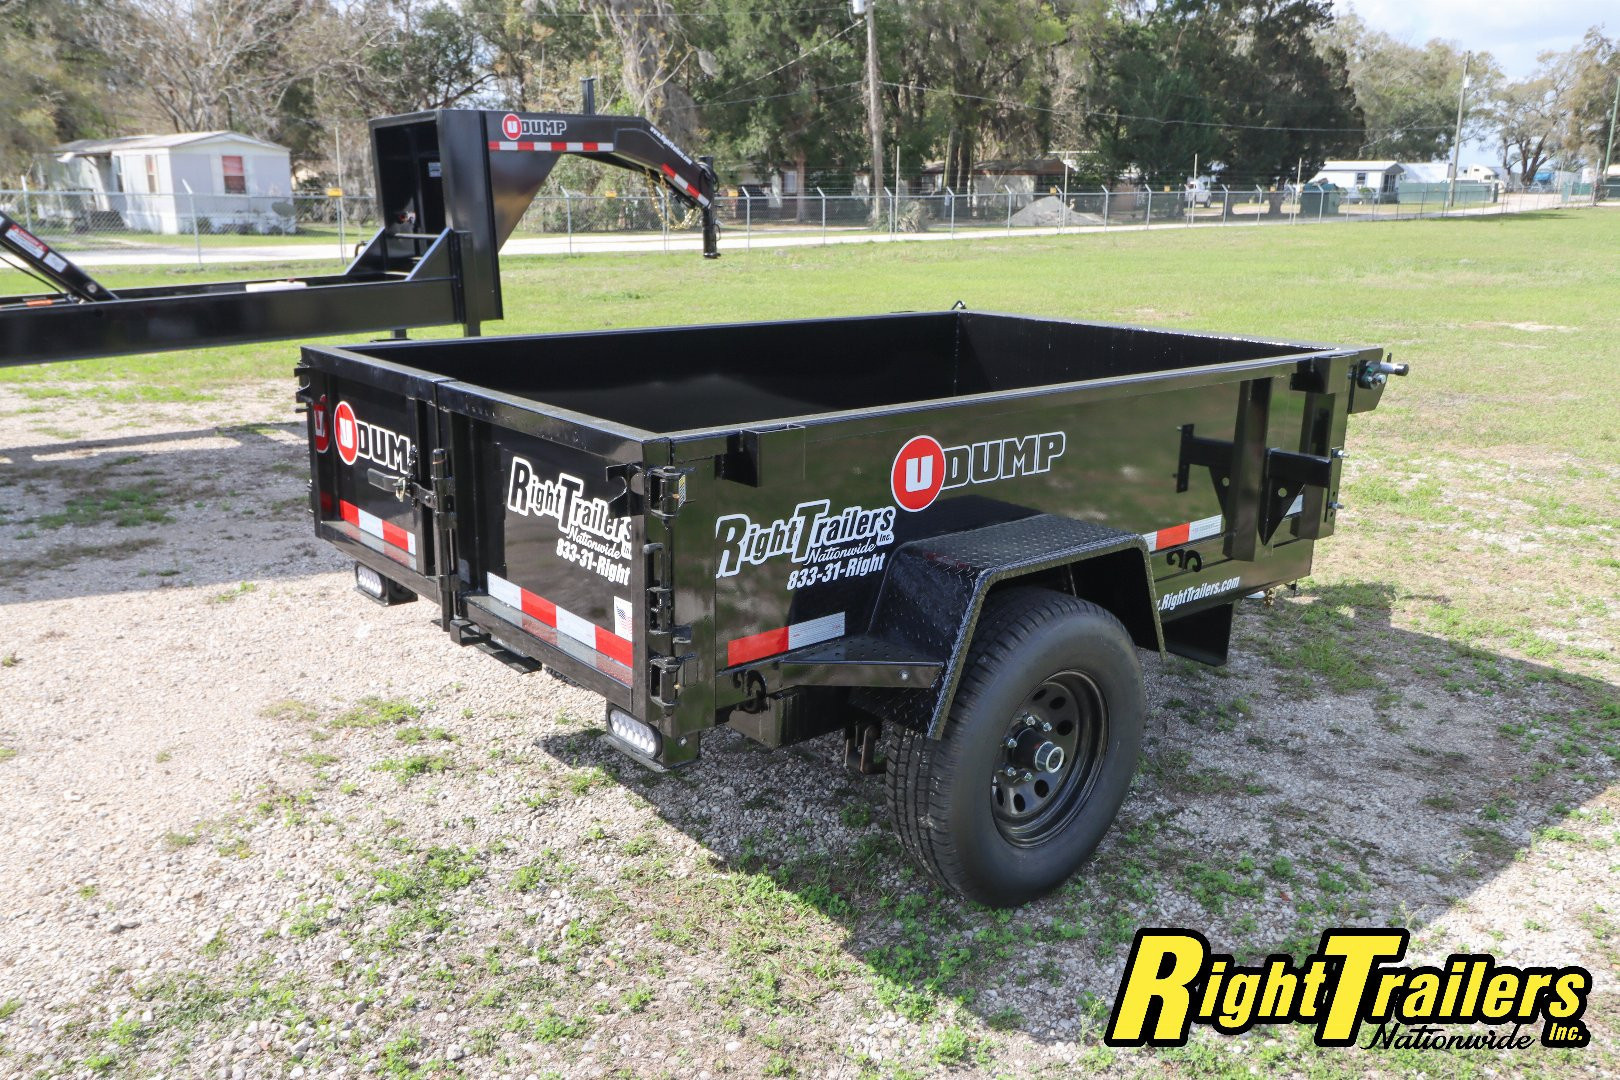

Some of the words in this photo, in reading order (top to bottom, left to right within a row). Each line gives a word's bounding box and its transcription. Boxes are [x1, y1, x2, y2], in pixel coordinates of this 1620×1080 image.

[356, 419, 411, 475] DUM
[556, 537, 631, 586] 833-31-Right
[566, 525, 622, 559] Nationwide
[803, 537, 877, 566] Nationwide
[786, 552, 886, 591] 833-31-Right
